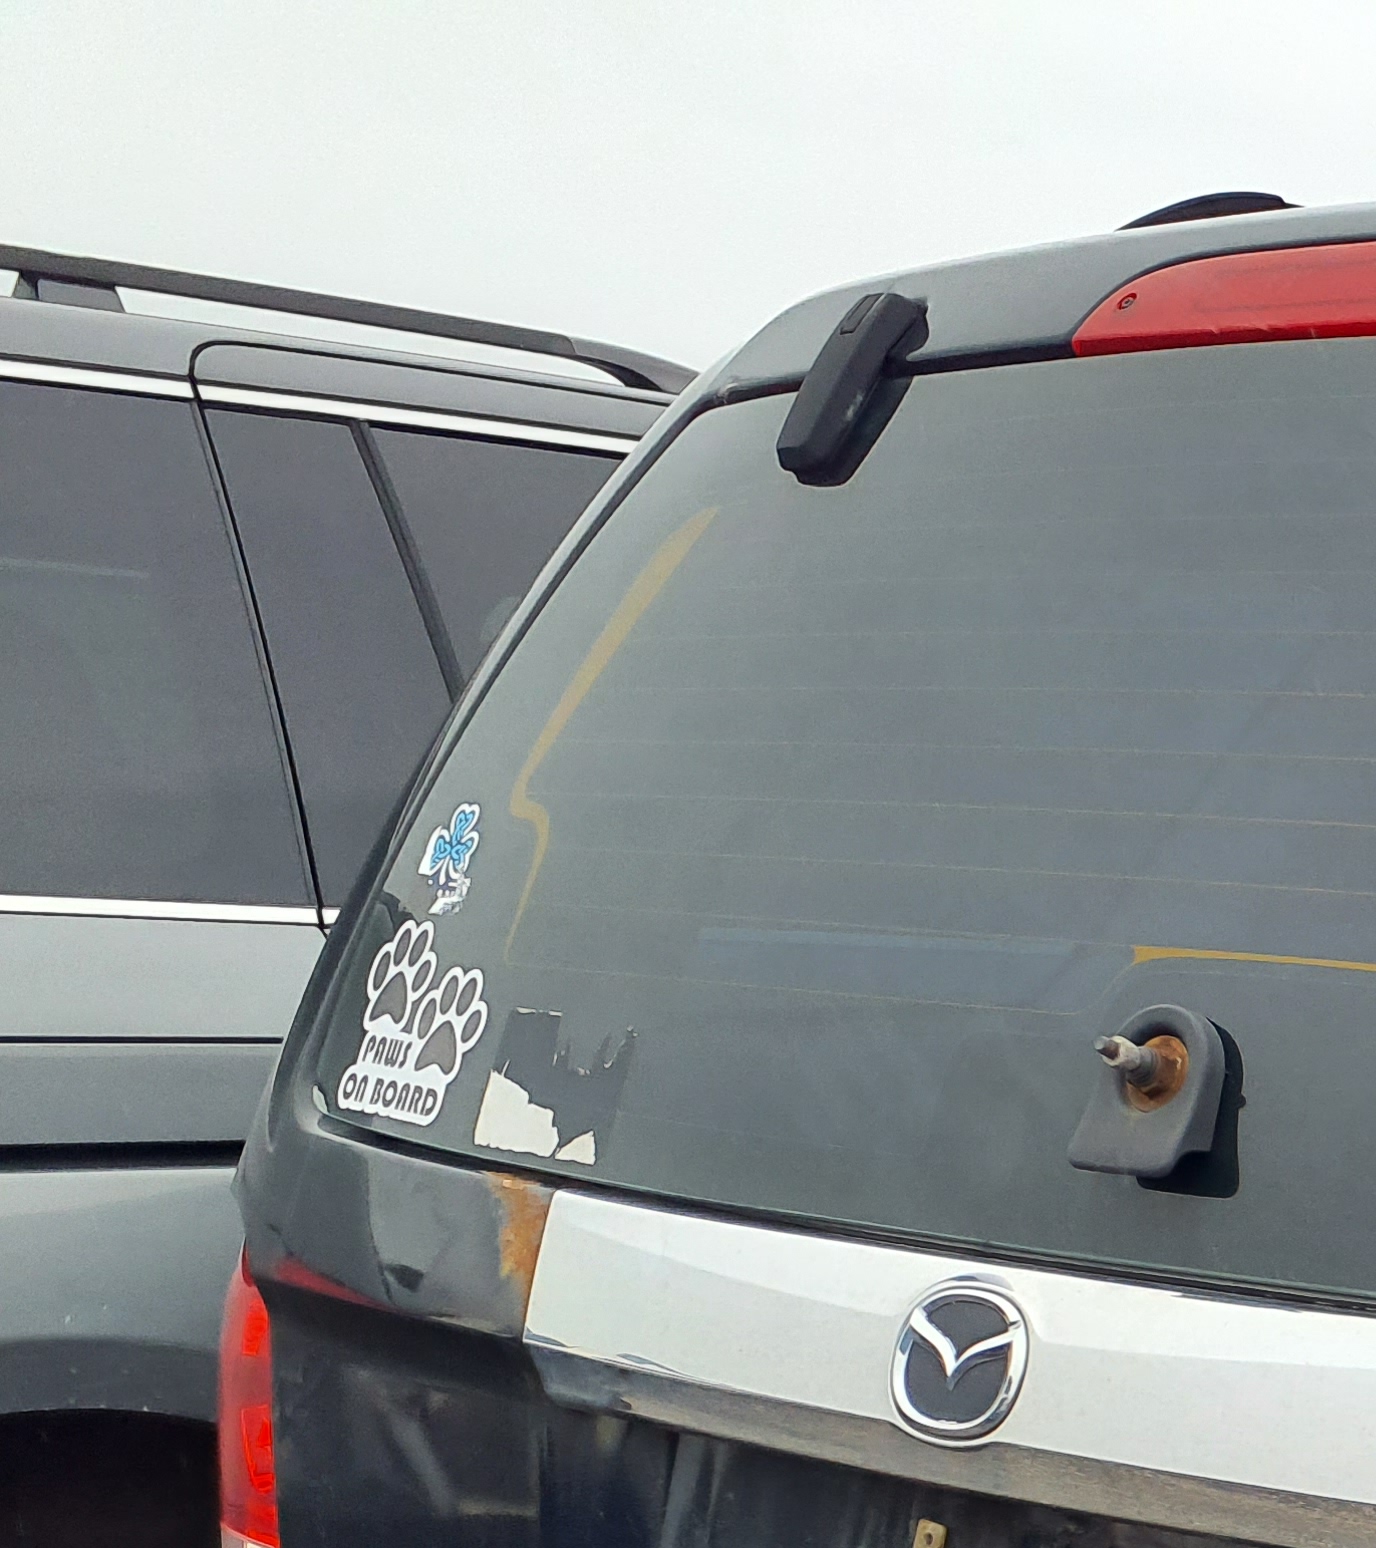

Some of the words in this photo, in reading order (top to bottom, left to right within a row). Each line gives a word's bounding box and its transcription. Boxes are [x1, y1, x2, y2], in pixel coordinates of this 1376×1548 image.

[362, 1034, 412, 1070] PAWS
[343, 1072, 369, 1103] ON
[369, 1077, 438, 1117] BOARD
